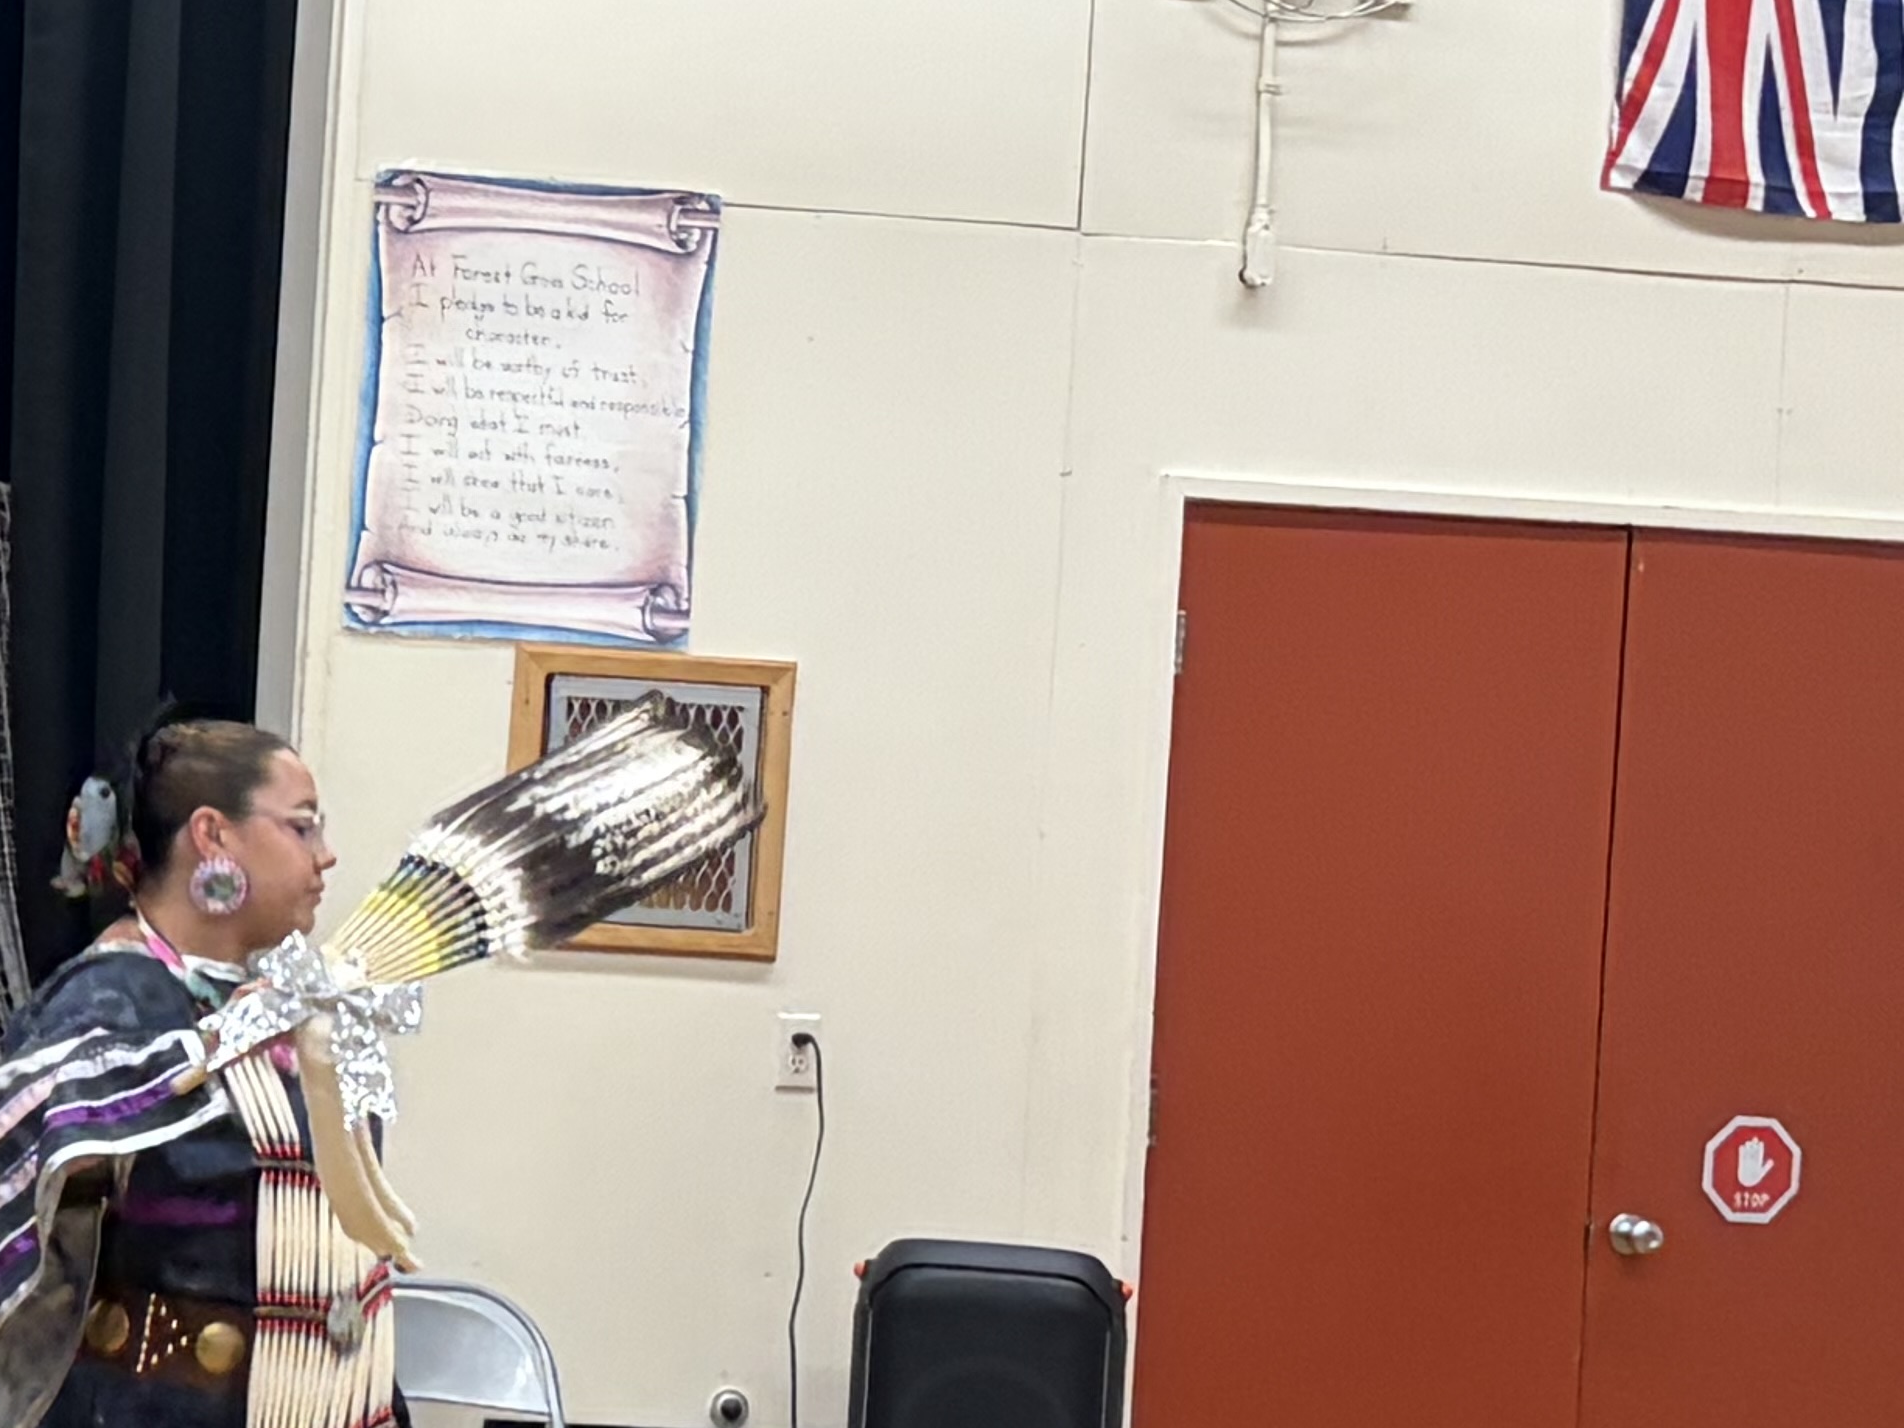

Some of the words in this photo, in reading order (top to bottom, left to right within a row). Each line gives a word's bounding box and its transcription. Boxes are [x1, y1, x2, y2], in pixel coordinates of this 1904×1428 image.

[411, 253, 436, 277] At
[451, 254, 511, 284] Forest
[572, 264, 639, 296] School
[408, 282, 429, 308] I
[503, 293, 518, 316] to
[525, 292, 545, 318] be
[551, 309, 561, 320] a
[601, 299, 629, 323] for
[404, 342, 428, 365] I
[471, 345, 492, 370] be
[561, 359, 579, 378] of
[405, 372, 426, 394] I
[464, 373, 484, 399] be
[512, 408, 529, 434] I
[400, 433, 421, 456] I
[402, 463, 420, 485] I
[553, 474, 565, 495] I
[400, 486, 422, 513] I
[460, 496, 479, 518] be
[491, 510, 501, 521] a
[1733, 1191, 1771, 1209] STOP
